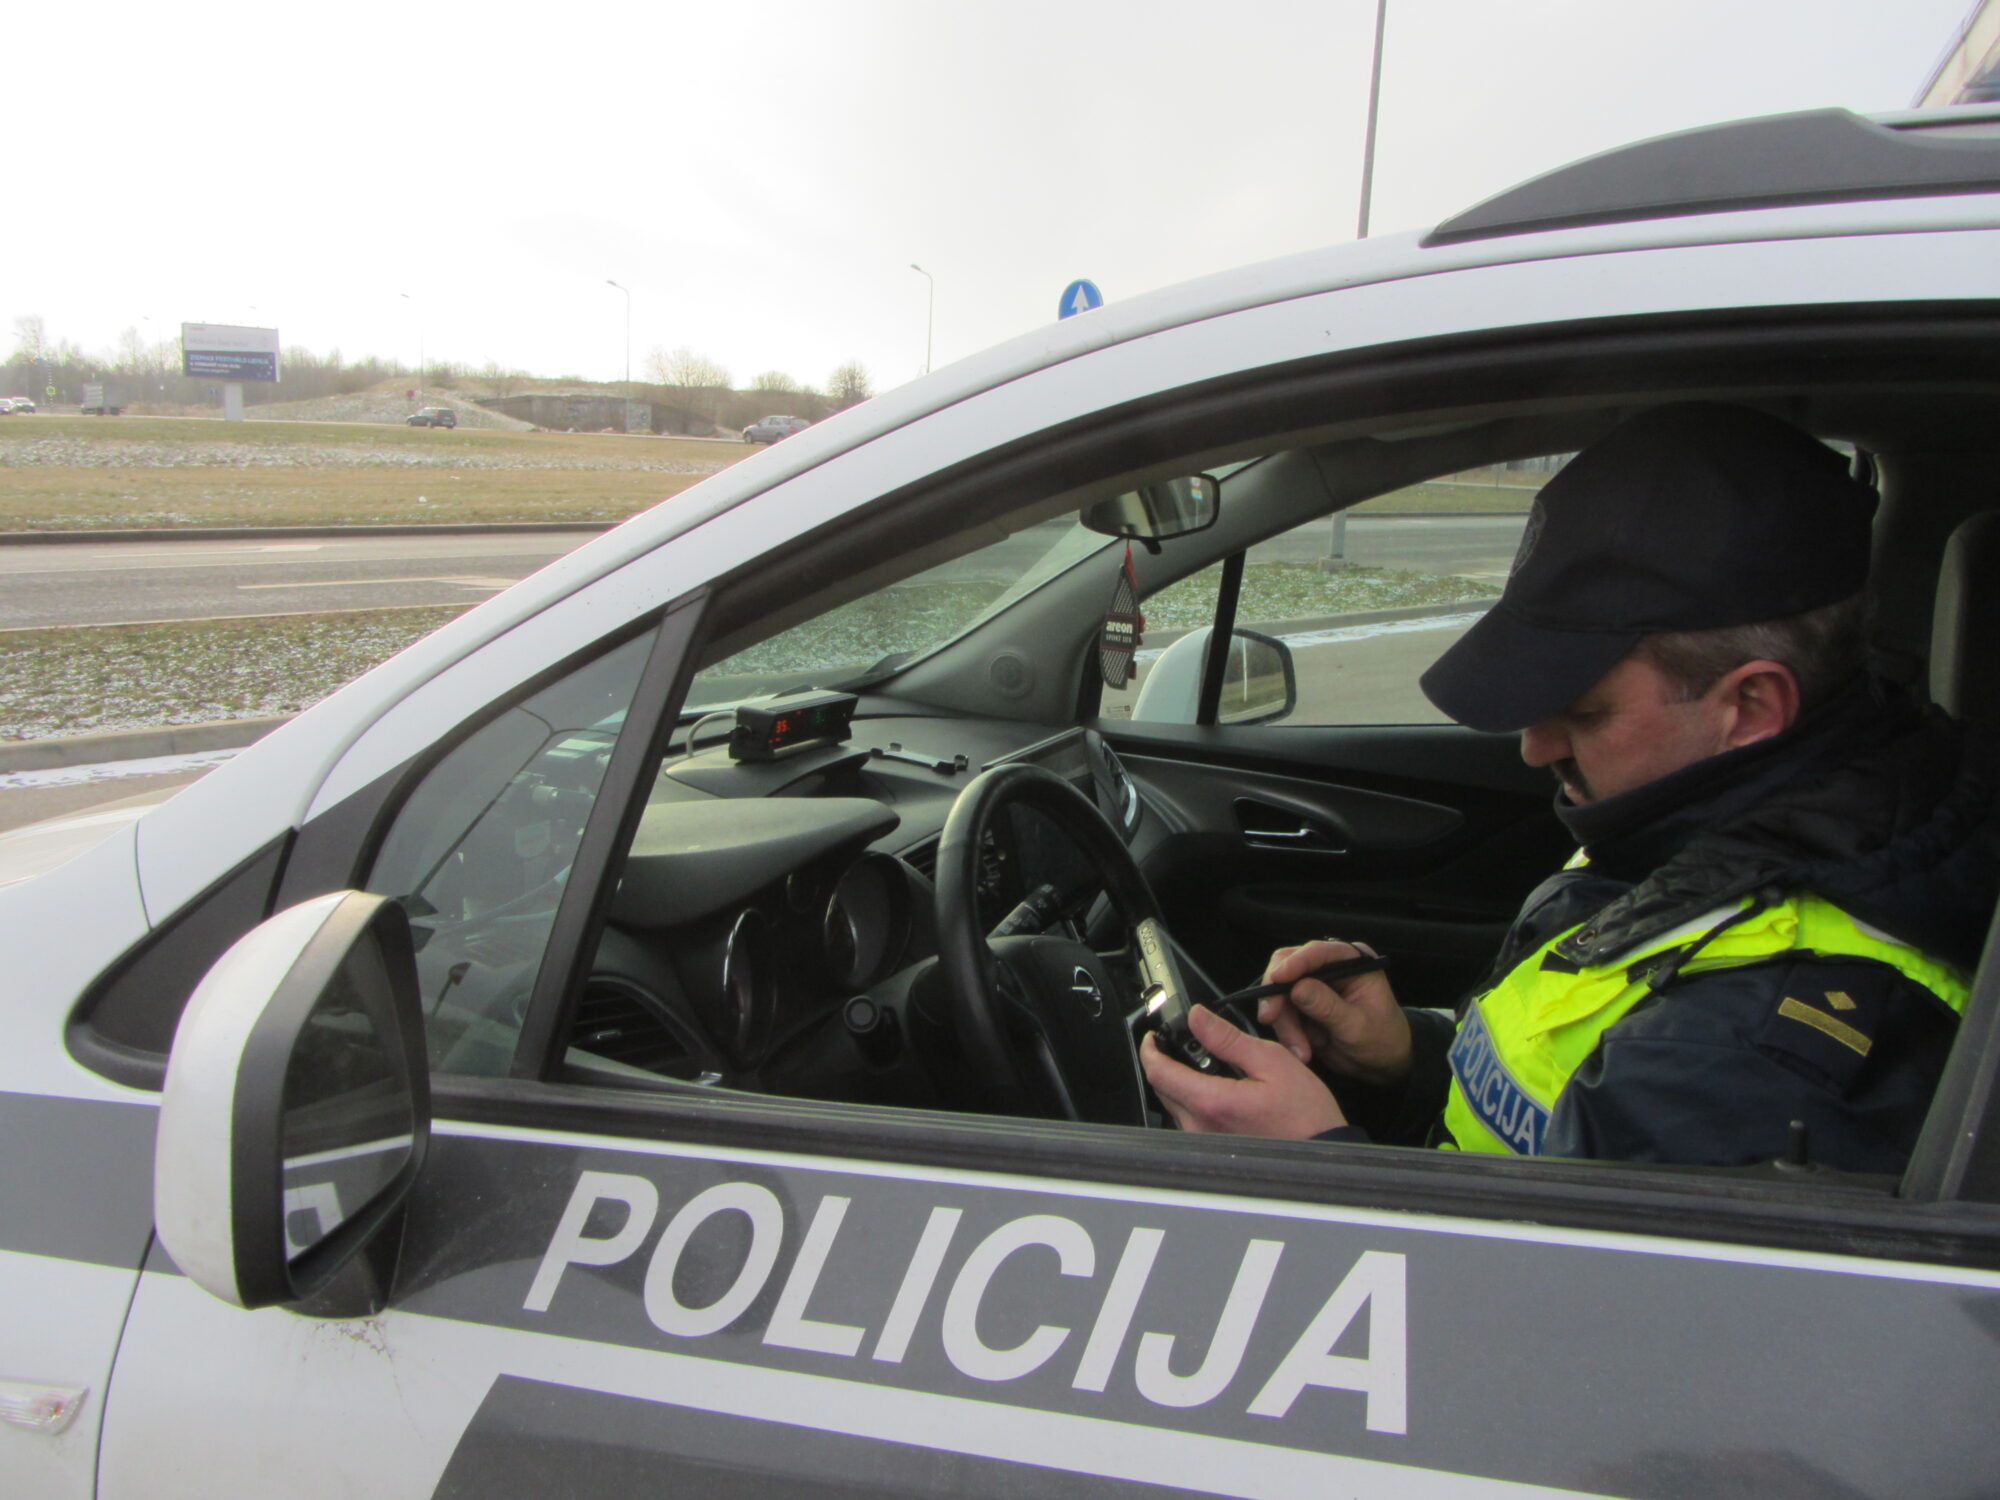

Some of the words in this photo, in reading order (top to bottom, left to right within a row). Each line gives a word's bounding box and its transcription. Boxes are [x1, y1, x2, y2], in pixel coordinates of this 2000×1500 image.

[1106, 621, 1133, 634] areon
[1456, 1018, 1536, 1155] POLICIJA
[522, 1170, 1407, 1434] POLICIJA
